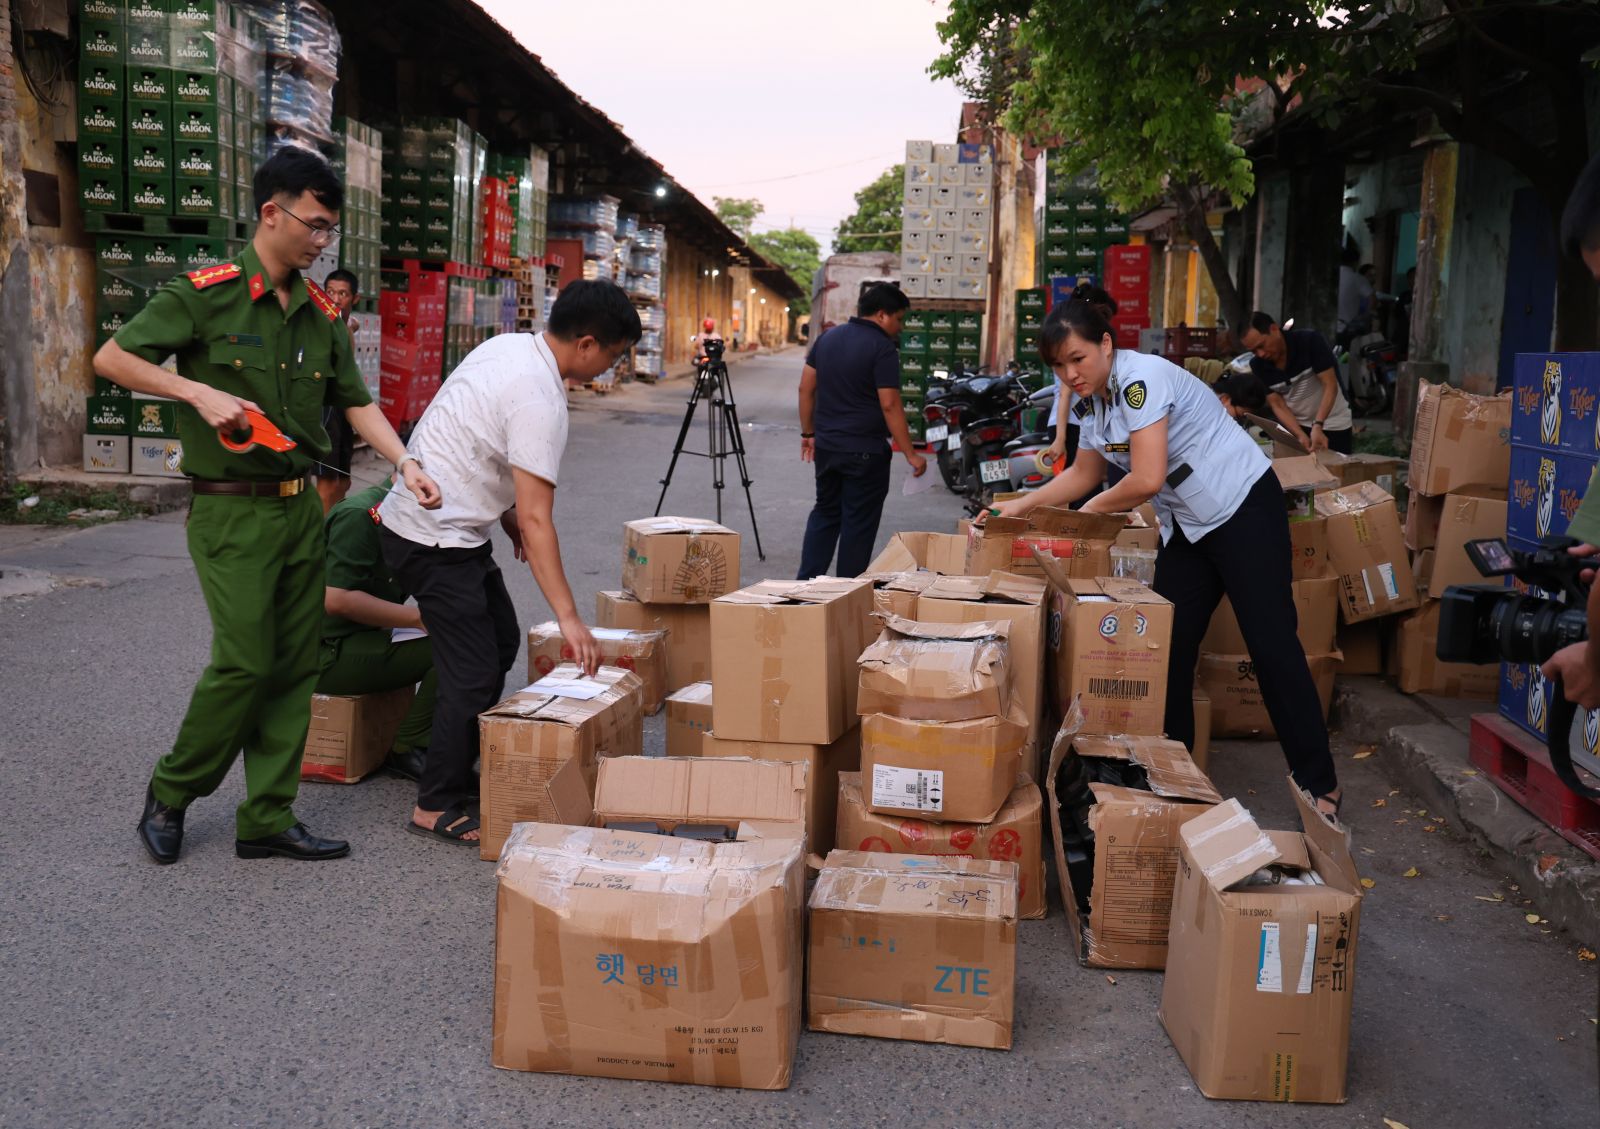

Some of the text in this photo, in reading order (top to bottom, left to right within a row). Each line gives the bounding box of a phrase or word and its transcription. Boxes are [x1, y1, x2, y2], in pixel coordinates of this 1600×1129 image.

[131, 9, 163, 17] SAIGON
[177, 11, 209, 20] SAIGON
[84, 80, 117, 90] SAIGON
[133, 84, 165, 93] SAIGON
[178, 87, 210, 96] SAIGON
[84, 118, 116, 127] SAIGON
[131, 121, 164, 131] SAIGON
[179, 124, 212, 133] SAIGON
[82, 154, 114, 164] SAIGON
[133, 158, 166, 168] SAIGON
[180, 161, 212, 170] SAIGON
[84, 191, 116, 200] SAIGON
[134, 195, 166, 204] SAIGON
[181, 197, 213, 206] SAIGON
[101, 251, 132, 261] SAIGON
[145, 254, 176, 263] SAIGON
[188, 256, 218, 264] SAIGON
[102, 287, 133, 296] SAIGON
[1519, 386, 1541, 416] Tiger
[1570, 386, 1596, 420] Tiger
[93, 416, 125, 424] SAIGON
[138, 425, 164, 433] SAIGON
[141, 446, 164, 458] Tiger
[1513, 478, 1536, 509] Tiger
[1254, 908, 1268, 917] CANS
[595, 953, 679, 987] 햇 당면
[934, 965, 991, 996] ZTE
[597, 1056, 628, 1065] PRODUCT
[644, 1060, 675, 1068] VIETNAM
